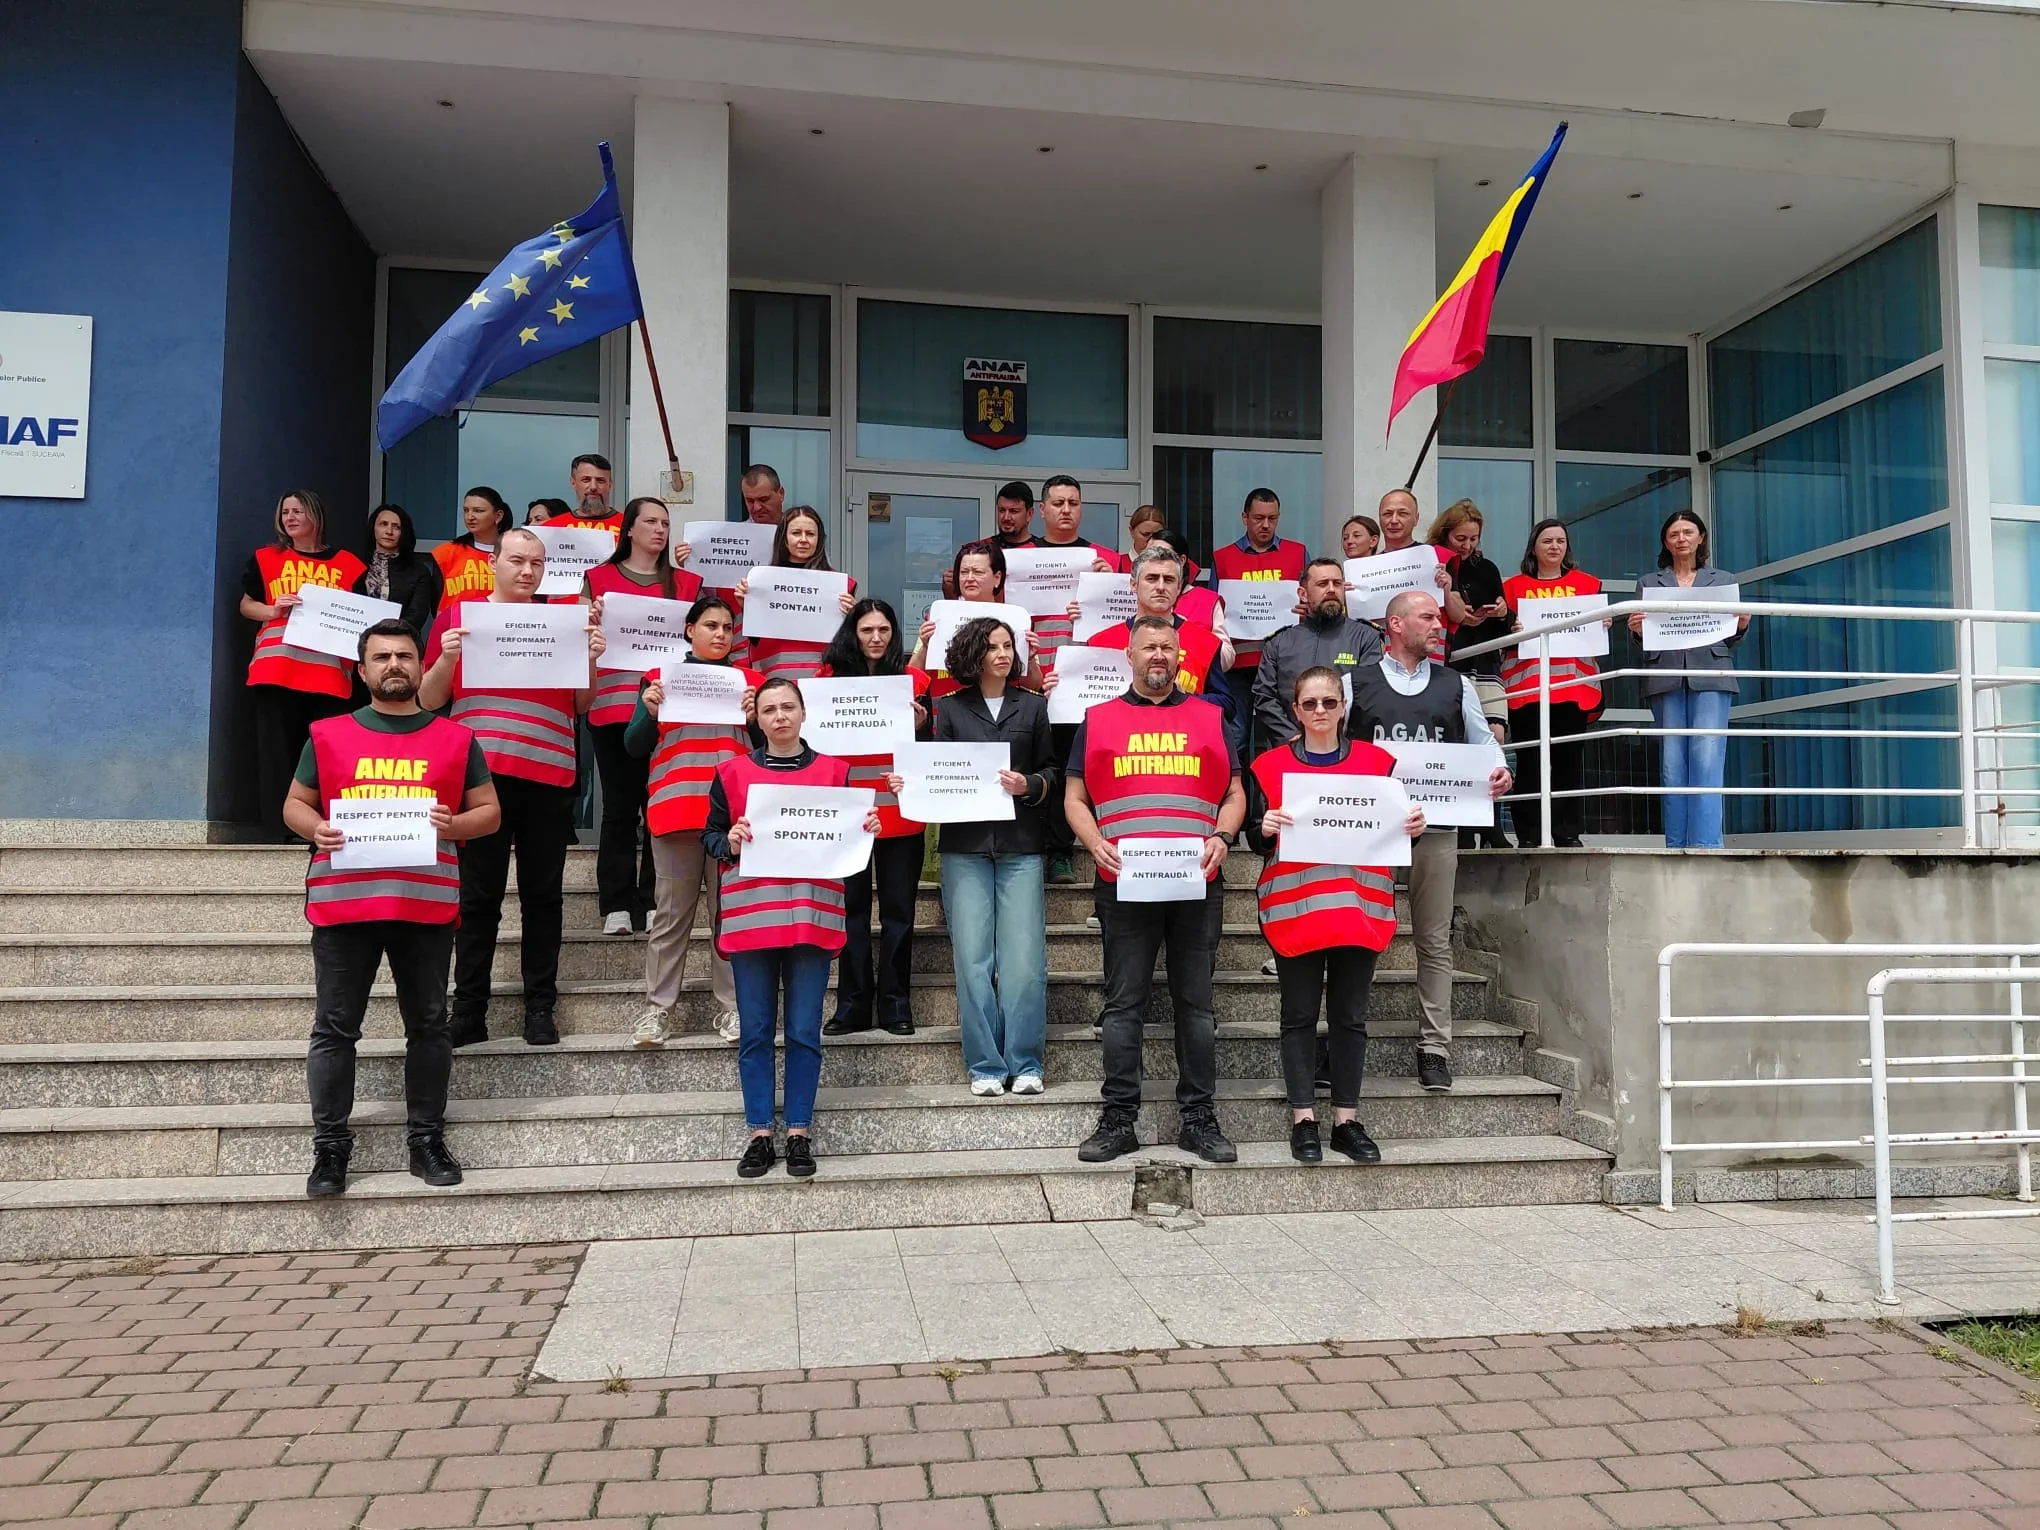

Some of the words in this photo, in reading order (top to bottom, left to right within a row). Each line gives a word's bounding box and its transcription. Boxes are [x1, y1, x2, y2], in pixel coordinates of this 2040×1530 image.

[966, 360, 1026, 374] ANAF
[17, 375, 46, 383] Publice
[32, 450, 66, 459] SUCEAVA
[710, 537, 750, 546] RESPECT
[712, 548, 747, 556] PENTRU
[699, 558, 755, 567] ANTIFRAUDĂ
[280, 560, 342, 583] ANAF
[1361, 570, 1392, 578] RESPECT
[1393, 564, 1422, 573] PENTRU
[774, 584, 820, 595] PROTEST
[1370, 580, 1414, 592] ANTIFRAUDĂ
[769, 602, 817, 613] SPONTAN
[647, 615, 666, 624] ORE
[1660, 620, 1721, 628] VULNERABILITATE
[620, 627, 685, 640] SUPLIMENTAR
[632, 643, 669, 653] PLĂTITE
[1084, 674, 1125, 682] SEPARATĂ
[832, 695, 880, 704] RESPECT
[835, 708, 877, 716] PENTRU
[819, 719, 888, 729] ANTIFRAUDĂ
[1127, 733, 1188, 753] ANAF
[355, 757, 429, 781] ANAF
[1425, 762, 1446, 770] ORE
[1319, 796, 1376, 806] PROTEST
[1410, 794, 1451, 802] PLĂTITE
[336, 812, 383, 820] RESPECT
[780, 807, 839, 818] PROTEST
[1313, 818, 1373, 829] SPONTAN
[348, 833, 415, 842] ANTIFRAUDĂ
[774, 830, 834, 841] SPONTAN
[1132, 870, 1188, 879] ANTIFRAUDĂ
